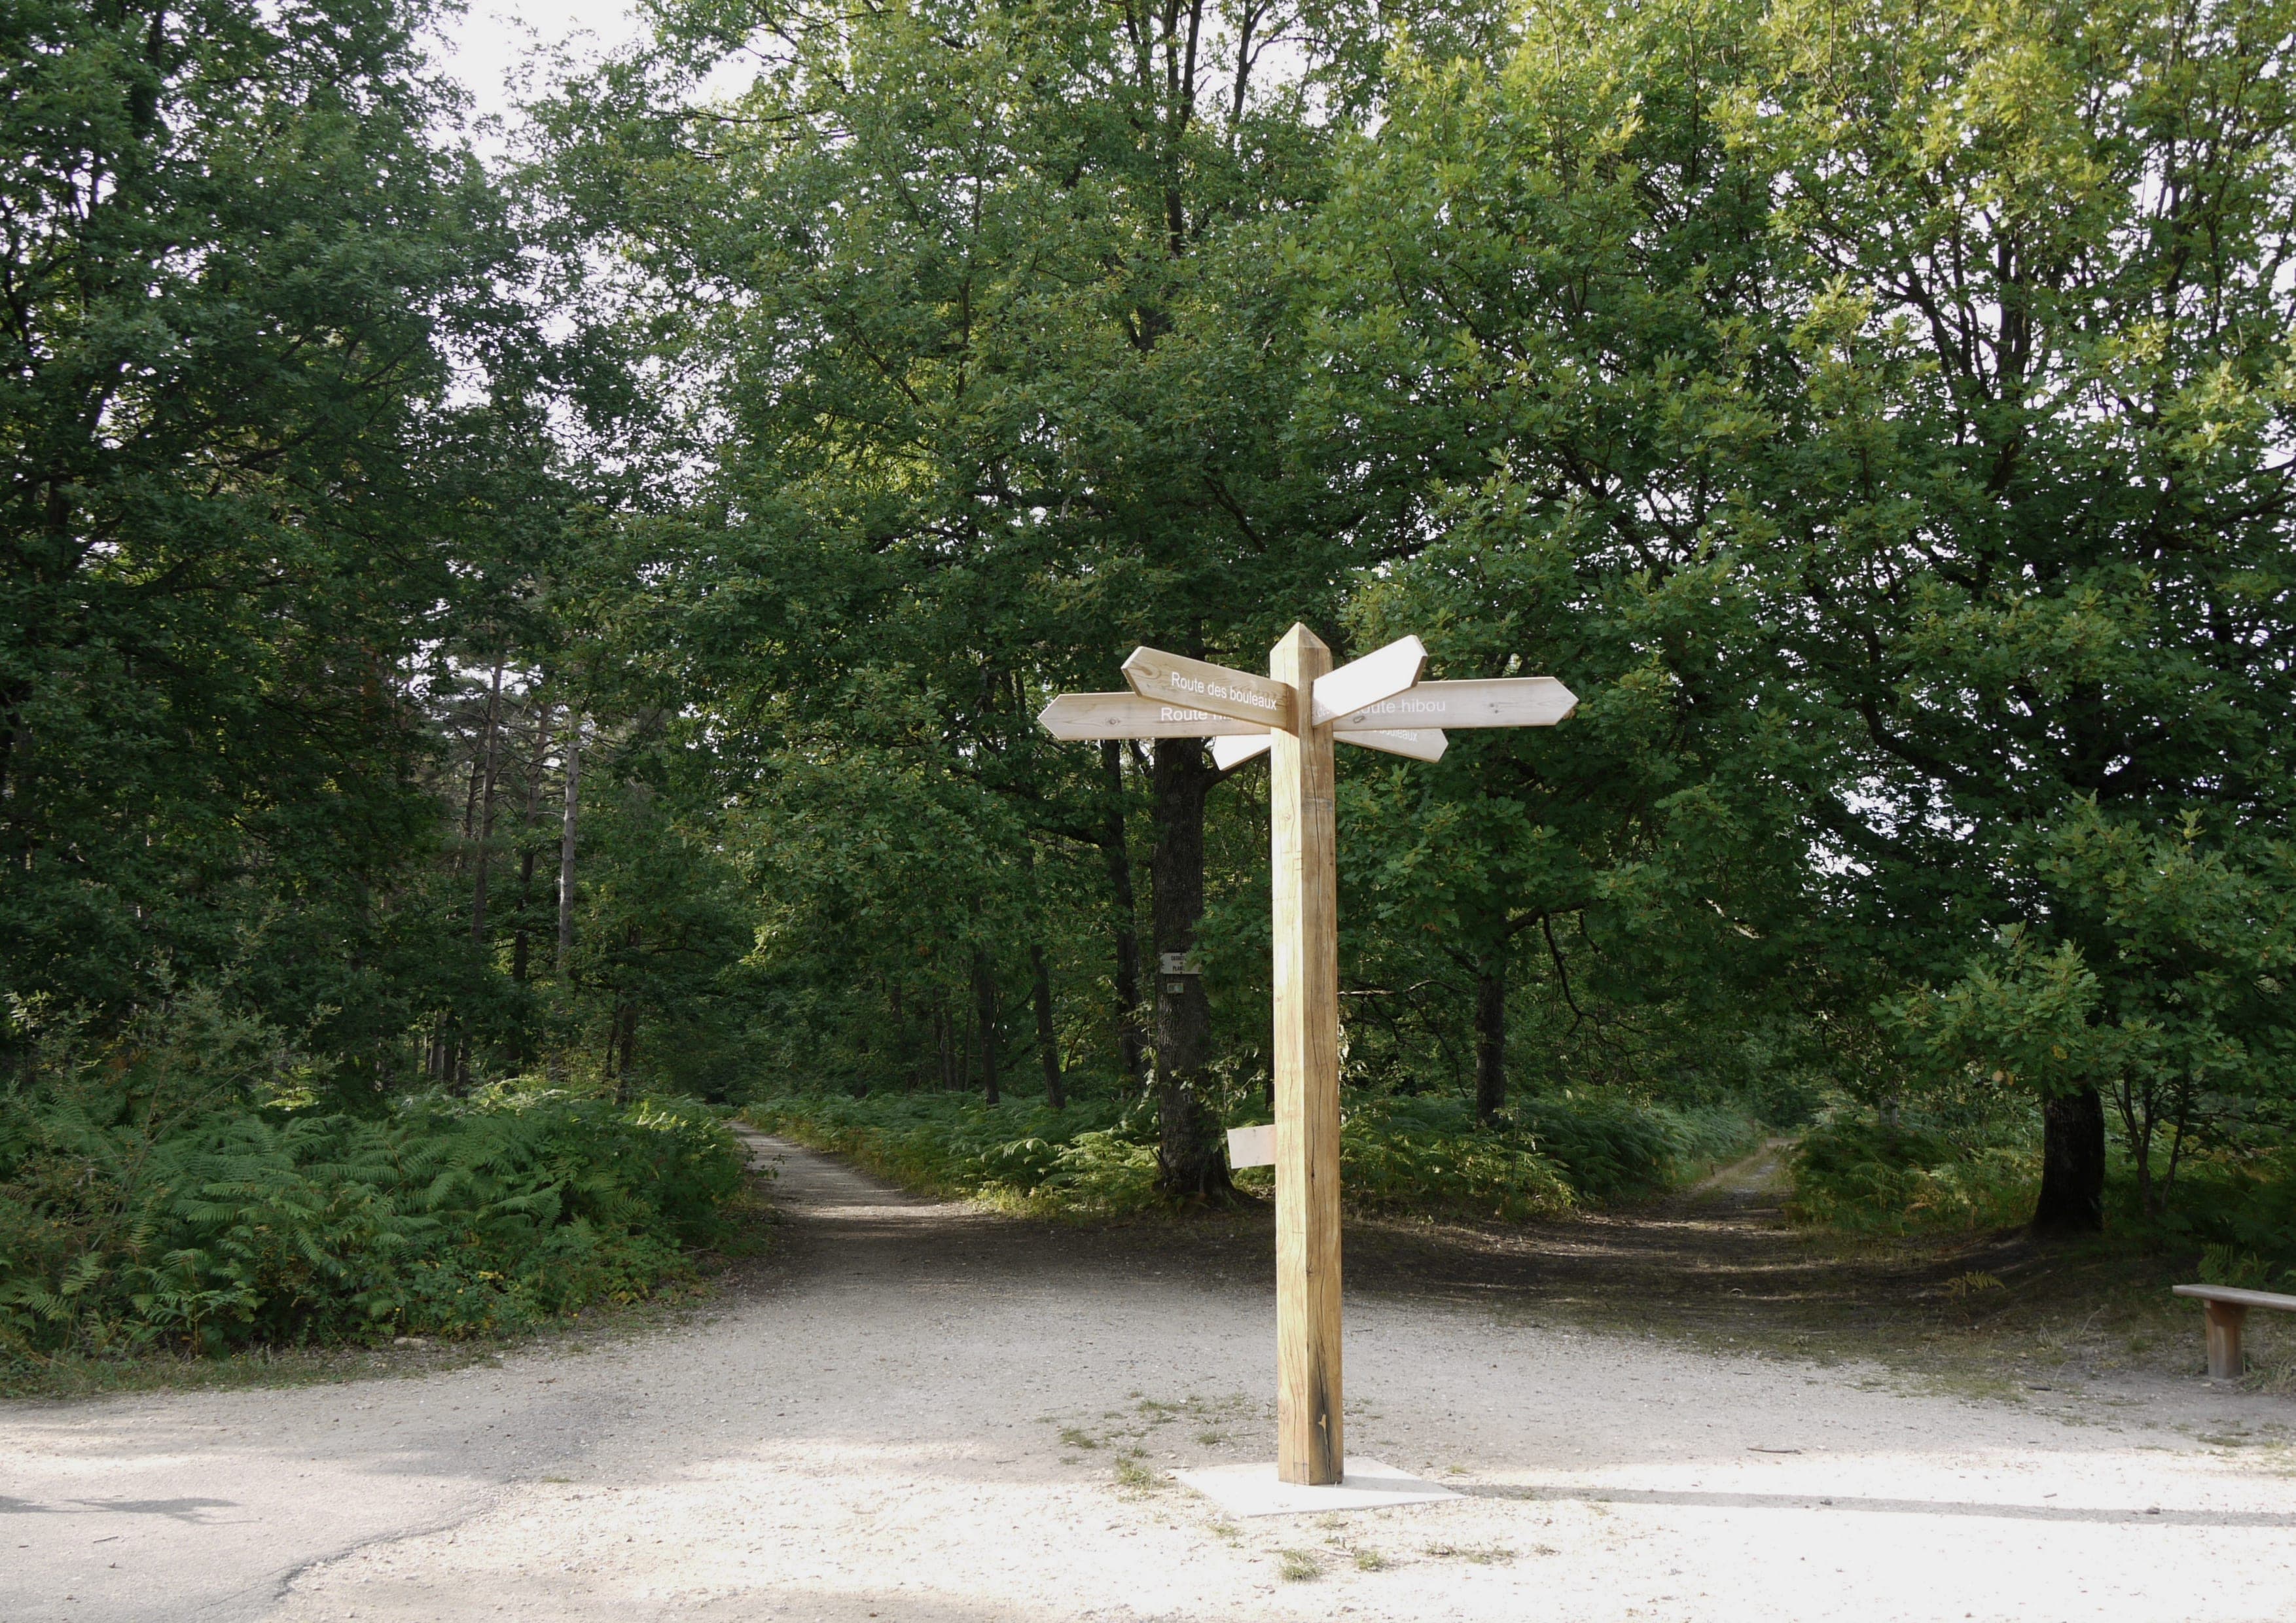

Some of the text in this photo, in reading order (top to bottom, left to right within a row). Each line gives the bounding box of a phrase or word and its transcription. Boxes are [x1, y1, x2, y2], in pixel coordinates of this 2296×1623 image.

[1171, 671, 1277, 710] Route des bouleaux
[1161, 707, 1208, 721] Route
[1357, 698, 1446, 714] oute hibou
